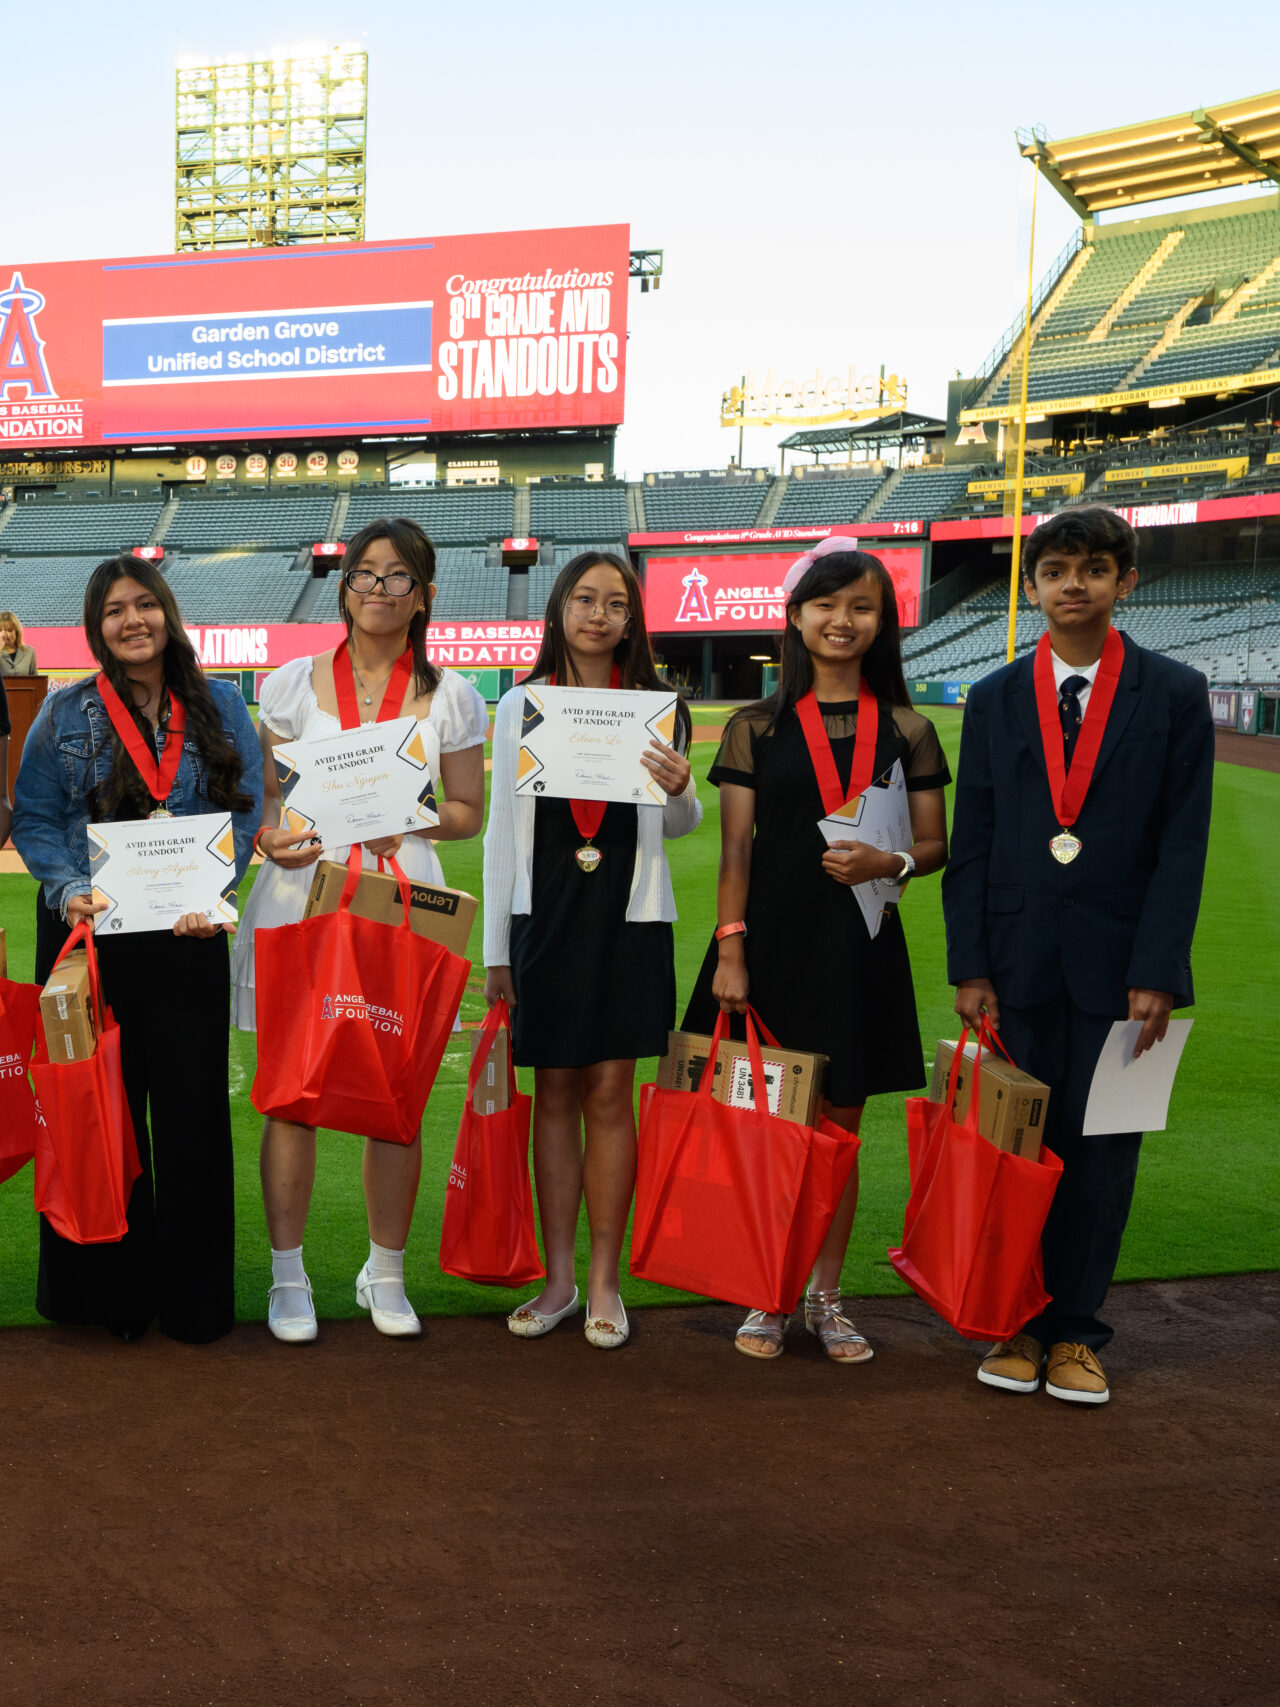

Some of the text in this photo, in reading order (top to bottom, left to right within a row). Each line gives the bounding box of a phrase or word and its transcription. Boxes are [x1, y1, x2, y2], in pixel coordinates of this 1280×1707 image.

[446, 268, 614, 298] Congratulations
[485, 291, 556, 337] GRADE
[559, 288, 611, 333] AVID
[192, 321, 339, 344] Garden Grove
[147, 343, 385, 373] Unified School District
[438, 332, 618, 400] STANDOUTS
[1099, 373, 1276, 404] RESTAURANT OPEN TO ALL FANS BREWERY
[11, 402, 83, 416] BASEBALL
[1050, 400, 1082, 409] STADIUM
[279, 456, 294, 467] 30
[310, 455, 324, 466] 42
[448, 459, 498, 468] CLASSIC HITS
[1111, 463, 1218, 479] BREWERY ANGEL STADIUM
[1132, 502, 1198, 528] FOUNDATION
[684, 532, 740, 543] Congratulations
[750, 529, 772, 539] Grade
[773, 528, 792, 538] AVID
[893, 522, 918, 534] 7:16
[714, 586, 785, 600] ANGELS
[714, 605, 785, 620] FOUN
[426, 626, 544, 640] ELS BASEBAL
[915, 683, 927, 693] 350
[561, 708, 636, 718] AVID 8TH GRADE
[572, 717, 622, 727] STANDOUT
[314, 745, 386, 767] AVID 8TH GRADE
[327, 756, 376, 772] STANDOUT
[125, 836, 197, 849] AVID 8TH GRADE
[137, 847, 185, 857] STANDOUT
[411, 891, 454, 911] Lenov
[335, 994, 404, 1024] ANGE SEBALL
[736, 1067, 747, 1100] UN 3481
